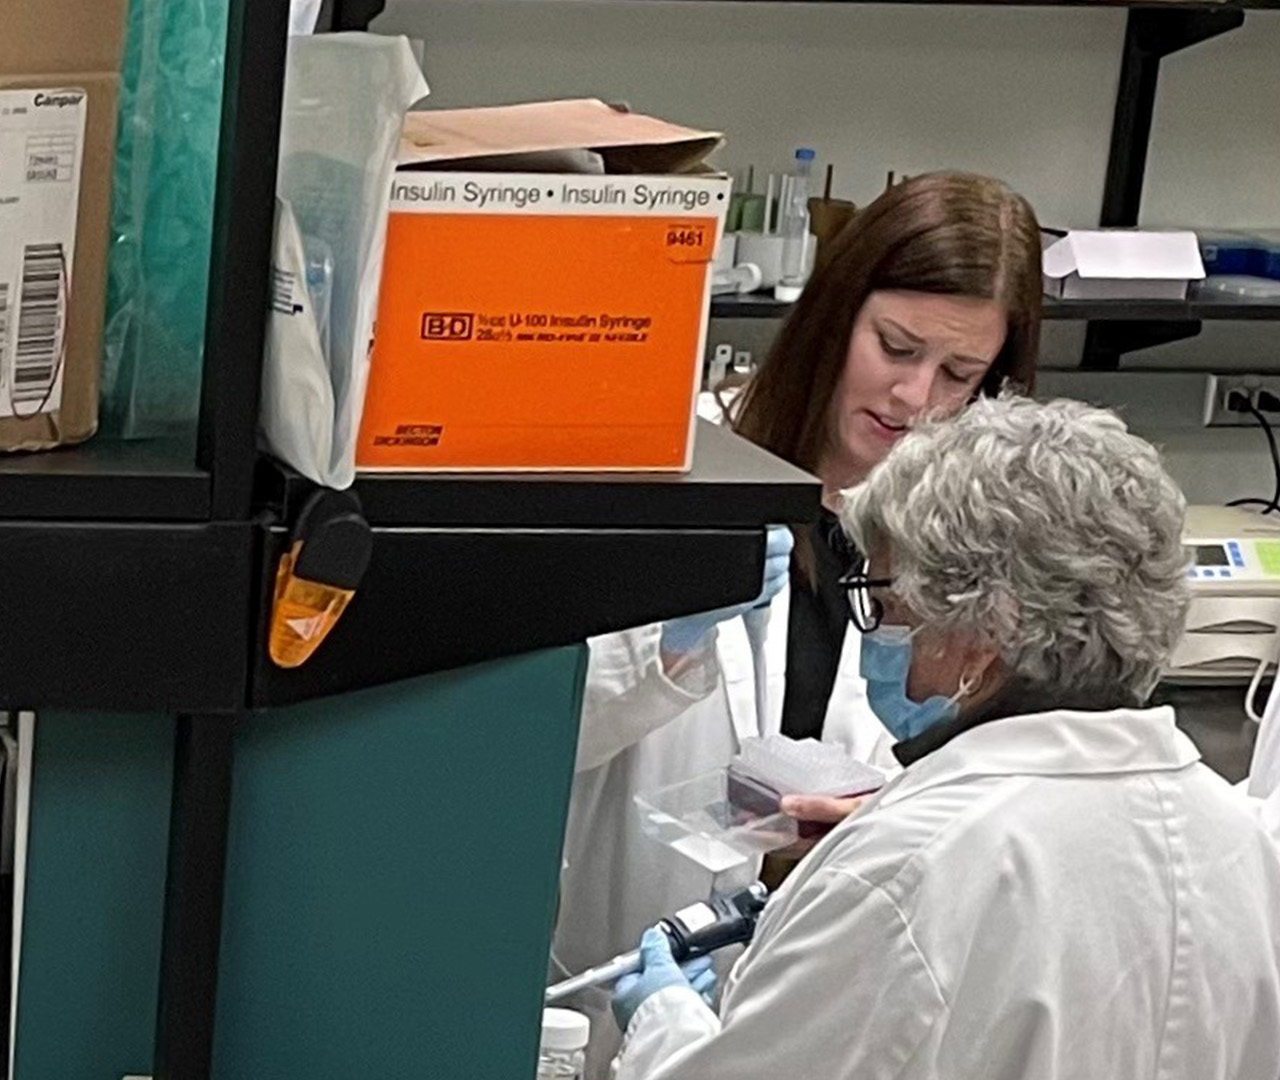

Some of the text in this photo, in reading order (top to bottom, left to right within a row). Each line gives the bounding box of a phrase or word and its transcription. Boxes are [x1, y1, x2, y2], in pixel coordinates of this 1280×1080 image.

[390, 181, 711, 209] Insulin Syringe Insulin Syringe
[600, 314, 652, 331] Syringe
